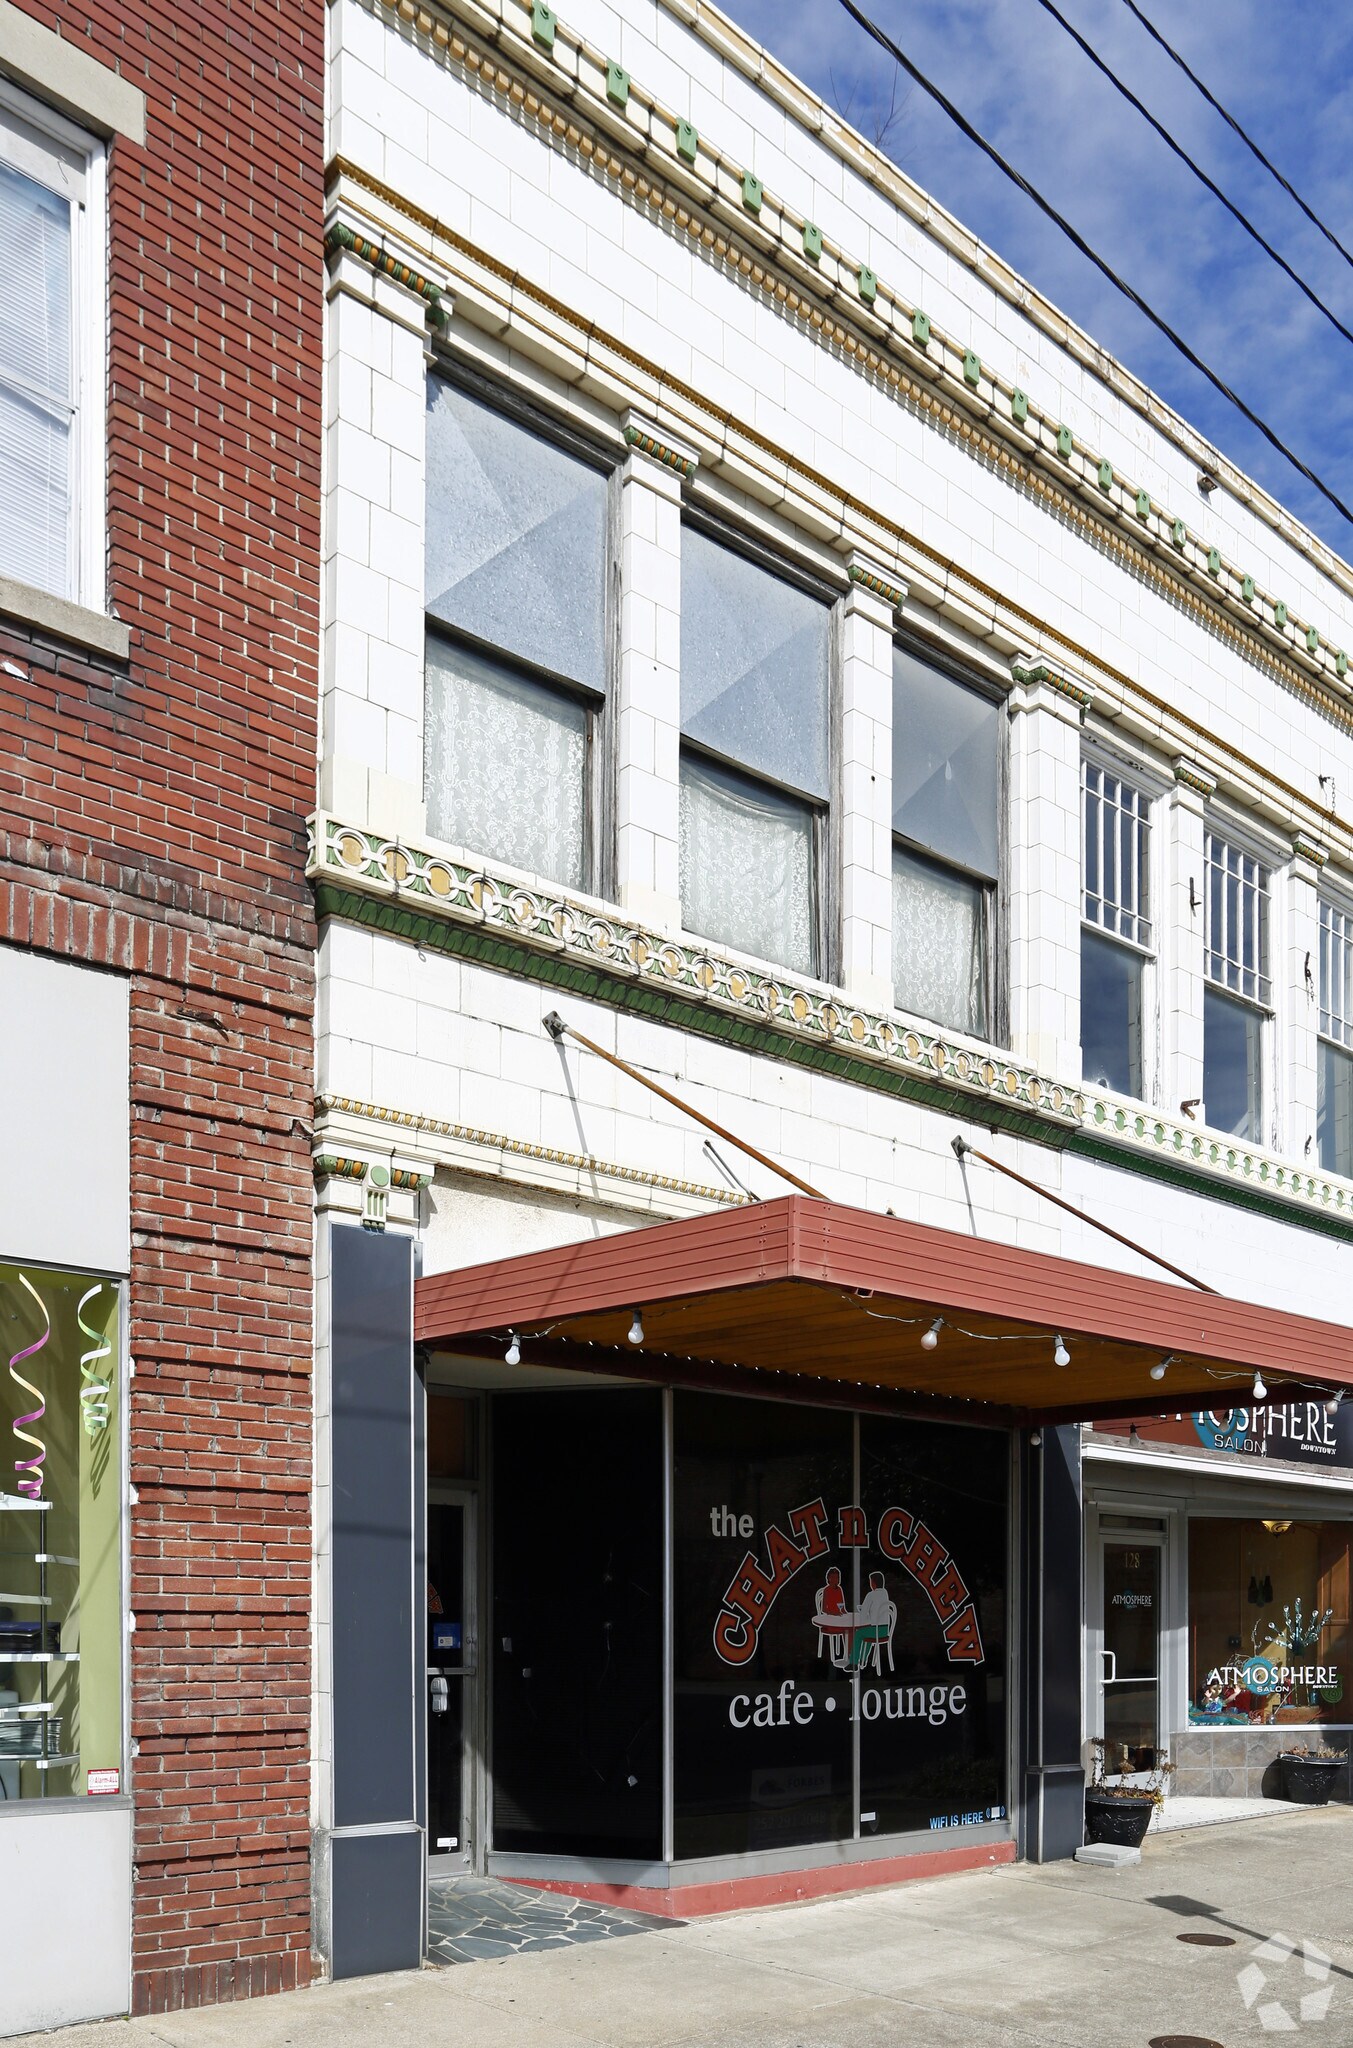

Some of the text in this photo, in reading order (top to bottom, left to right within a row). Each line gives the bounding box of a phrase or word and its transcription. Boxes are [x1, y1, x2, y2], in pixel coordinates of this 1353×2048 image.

[1214, 1434, 1267, 1453] SALON
[1301, 1443, 1337, 1455] DOWNTOWN
[710, 1505, 754, 1538] the
[1124, 1552, 1140, 1569] 128
[713, 1497, 985, 1666] CHAT n CHEW
[1111, 1594, 1152, 1605] ATMOSPHERE
[1206, 1666, 1338, 1685] ATMOSPHERE
[1256, 1685, 1290, 1693] SALON
[728, 1679, 967, 1728] cafe lounge
[929, 1811, 984, 1830] WIFI IS HERE
